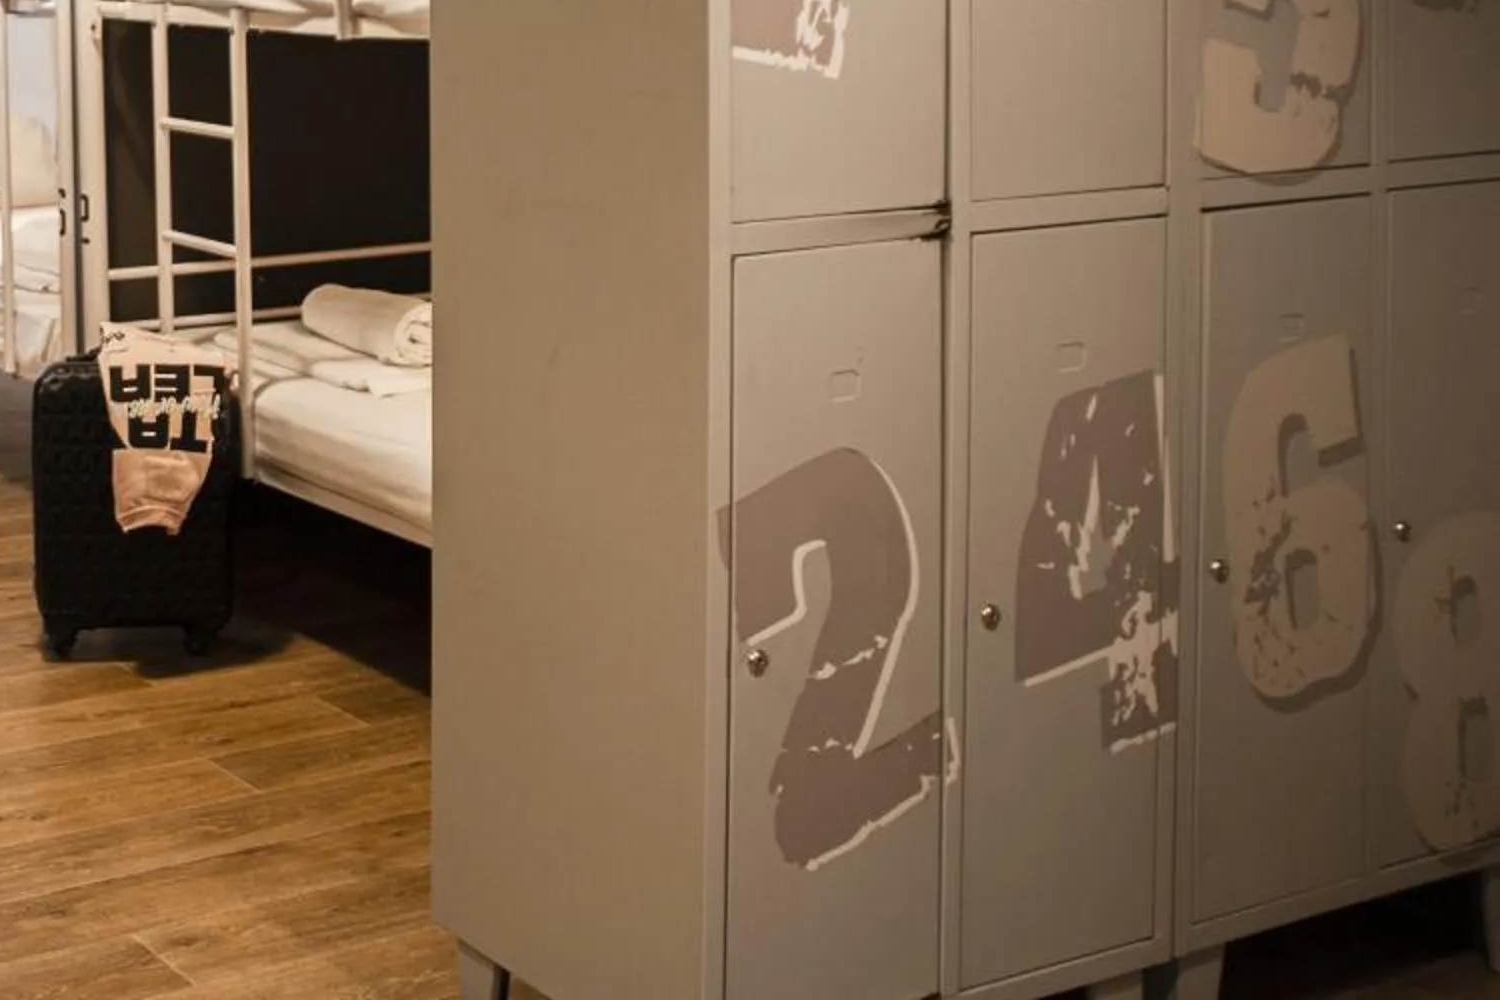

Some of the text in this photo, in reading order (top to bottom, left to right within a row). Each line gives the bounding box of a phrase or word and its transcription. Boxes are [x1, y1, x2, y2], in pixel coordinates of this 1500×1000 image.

[710, 446, 959, 871] 2
[1013, 369, 1180, 754] 4
[1221, 332, 1382, 714] 6
[1394, 509, 1500, 864] 8
